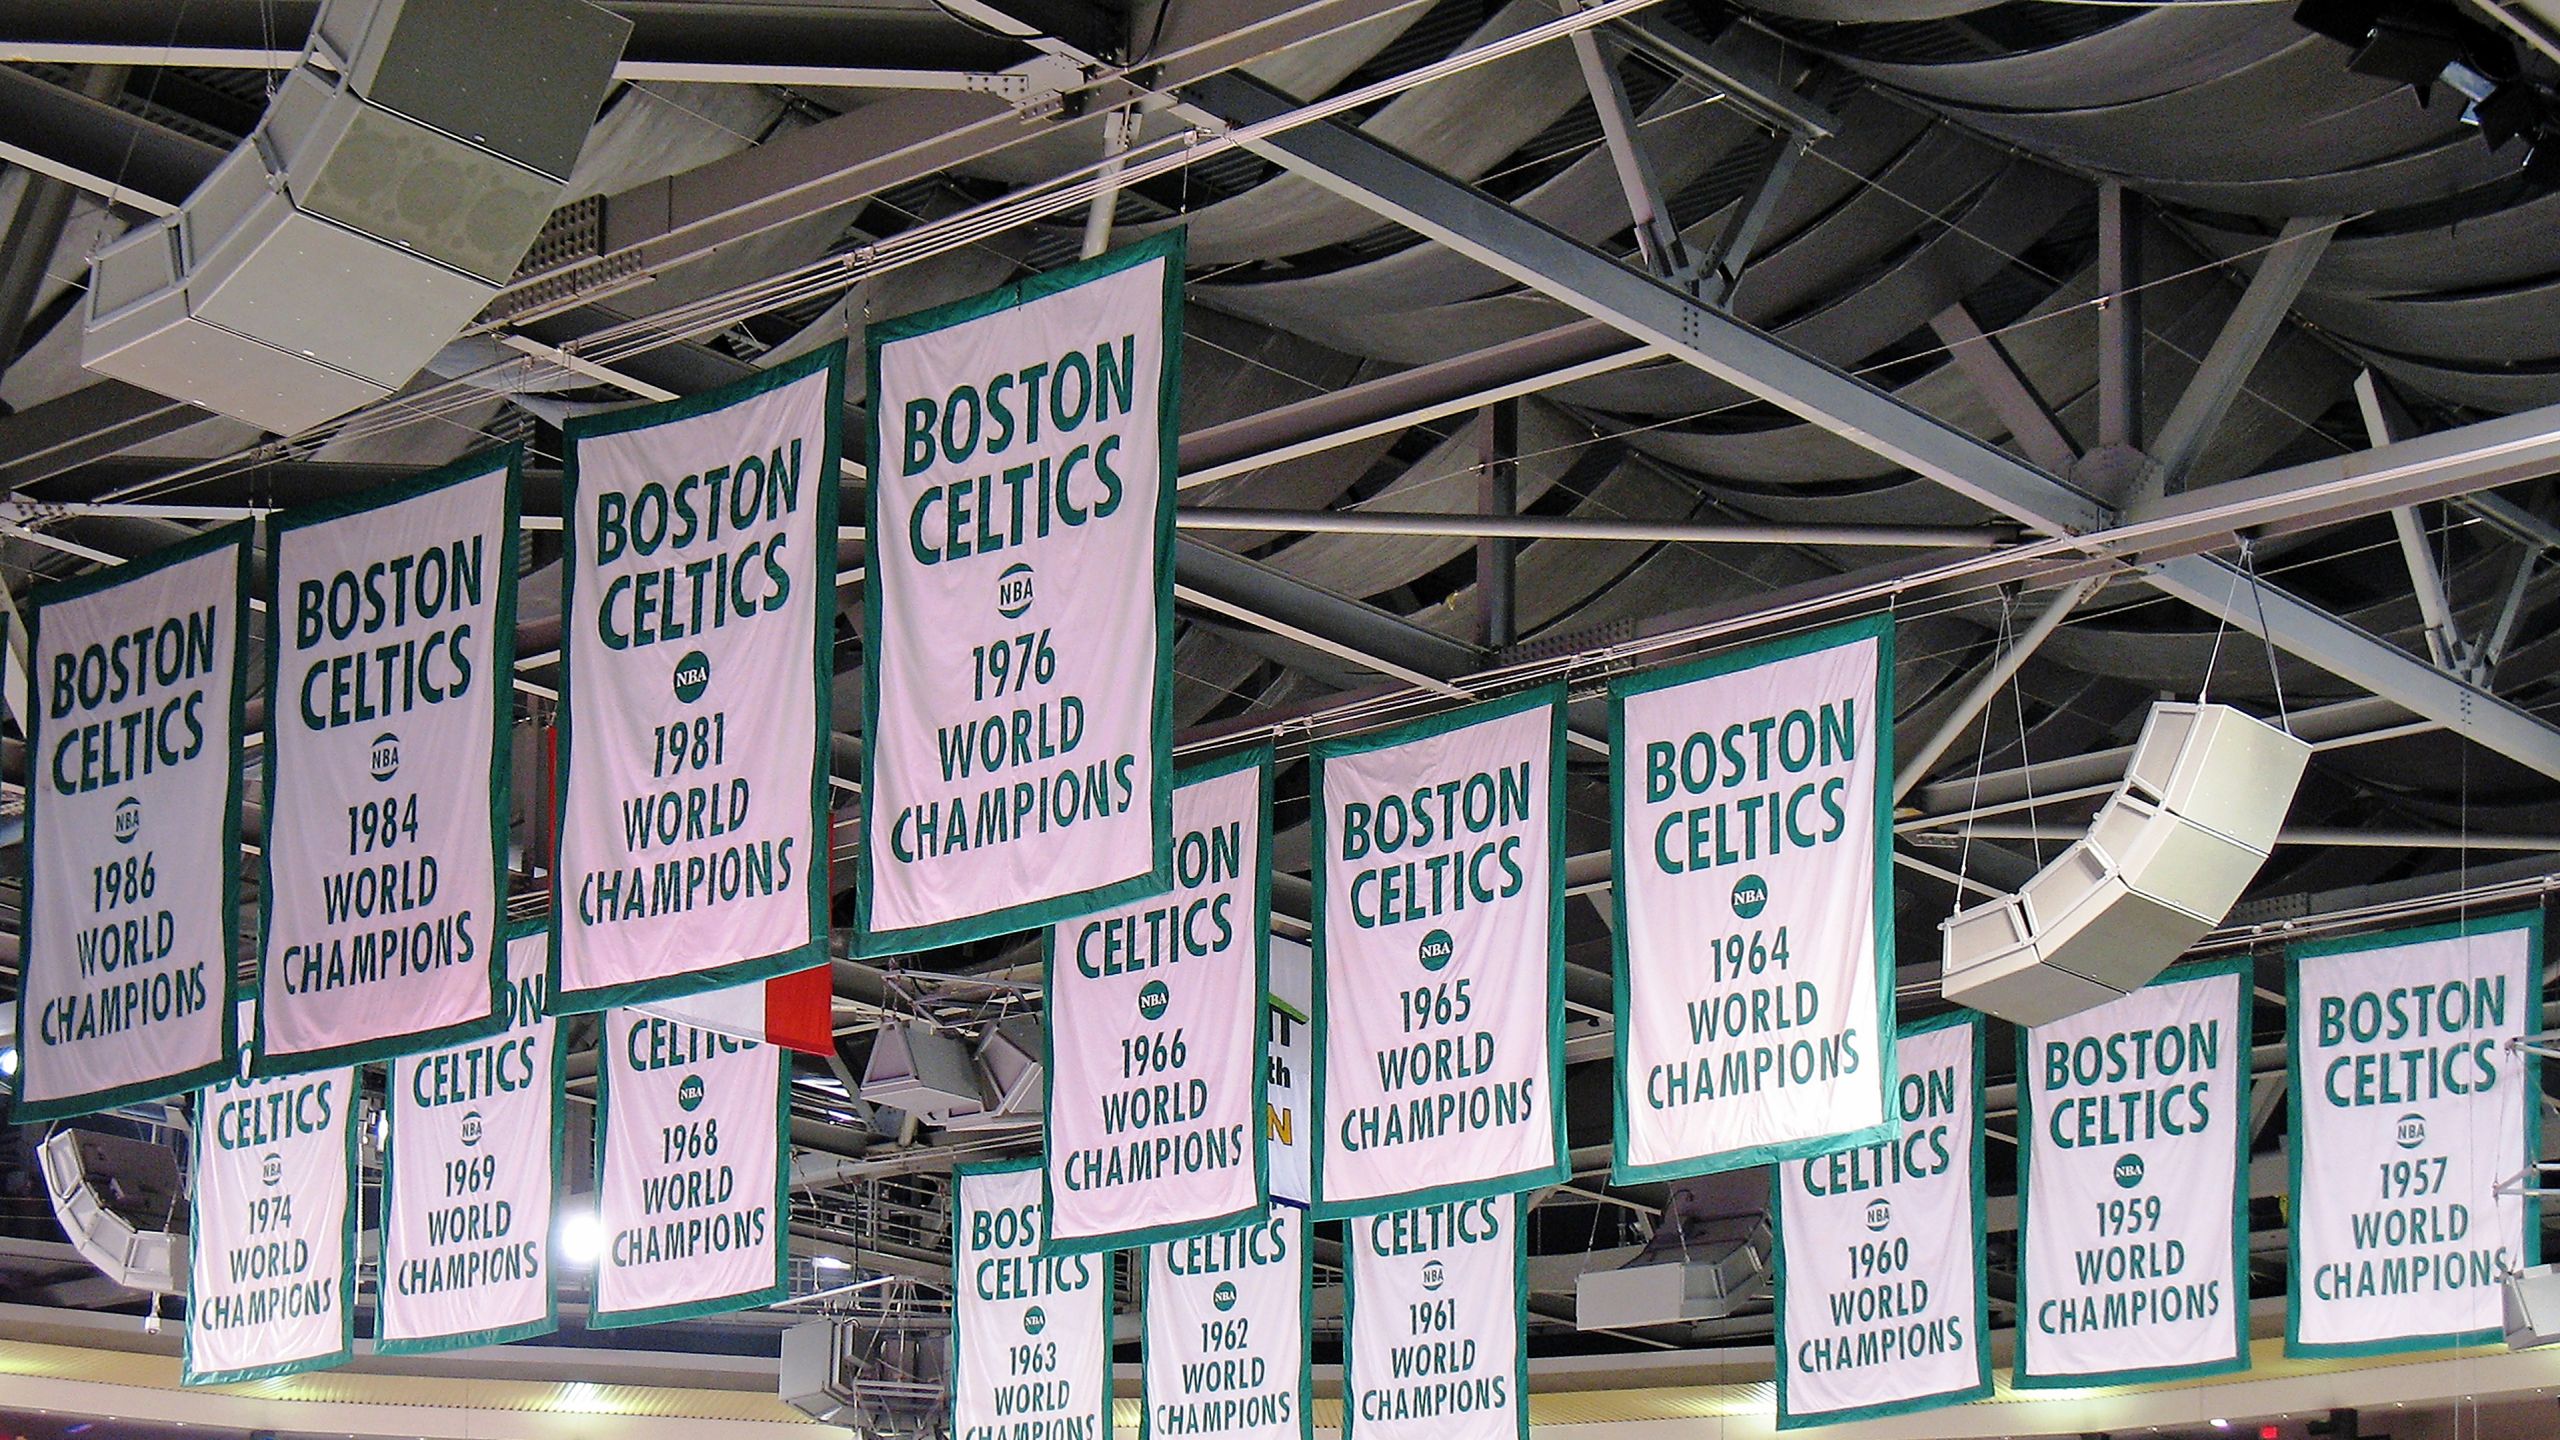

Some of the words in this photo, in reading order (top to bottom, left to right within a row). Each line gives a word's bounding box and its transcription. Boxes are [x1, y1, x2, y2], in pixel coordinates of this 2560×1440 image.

[903, 334, 1134, 477] BOSTON
[598, 438, 801, 566] BOSTON
[910, 435, 1122, 565] CELTICS
[297, 535, 482, 650] BOSTON
[598, 532, 790, 650] CELTICS
[999, 578, 1034, 605] NBA
[51, 606, 215, 719] BOSTON
[301, 624, 471, 730] CELTICS
[676, 666, 707, 688] NBA
[973, 628, 1055, 701] 1976
[53, 690, 203, 795] CELTICS
[372, 746, 399, 768] NBA
[654, 712, 723, 777] 1981
[938, 696, 1084, 781] WORLD
[1647, 698, 1854, 804] BOSTON
[115, 808, 139, 830] NBA
[349, 793, 418, 855] 1984
[623, 778, 749, 852] WORLD
[891, 754, 1134, 863] CHAMPIONS
[1343, 762, 1529, 861] BOSTON
[1655, 777, 1845, 874] CELTICS
[94, 851, 155, 912] 1986
[324, 856, 437, 925] WORLD
[580, 837, 793, 926] CHAMPIONS
[1351, 836, 1523, 928] CELTICS
[1735, 889, 1766, 906] NBA
[77, 911, 174, 979] WORLD
[283, 911, 473, 995] CHAMPIONS
[1077, 893, 1232, 979] CELTICS
[1420, 942, 1451, 960] NBA
[1711, 926, 1789, 982] 1964
[41, 962, 206, 1046] CHAMPIONS
[1140, 993, 1167, 1008] NBA
[1401, 979, 1470, 1032] 1965
[1688, 981, 1818, 1044] WORLD
[2319, 975, 2505, 1047] BOSTON
[414, 1036, 534, 1108] CELTICS
[1122, 1029, 1186, 1078] 1966
[1378, 1032, 1494, 1092] WORLD
[1648, 1029, 1859, 1110] CHAMPIONS
[2046, 1020, 2217, 1090] BOSTON
[2325, 1039, 2496, 1107] CELTICS
[218, 1081, 331, 1150] CELTICS
[680, 1086, 702, 1098] NBA
[1102, 1079, 1207, 1134] WORLD
[1341, 1078, 1532, 1152] CHAMPIONS
[2050, 1082, 2209, 1149] CELTICS
[461, 1119, 482, 1136] NBA
[663, 1119, 718, 1163] 1968
[2398, 1123, 2425, 1139] NBA
[446, 1155, 494, 1193] 1969
[1065, 1124, 1243, 1191] CHAMPIONS
[1803, 1125, 1949, 1197] CELTICS
[2116, 1163, 2143, 1178] NBA
[2381, 1157, 2447, 1199] 1957
[249, 1195, 291, 1234] 1974
[643, 1166, 733, 1214] WORLD
[1867, 1208, 1889, 1223] NBA
[2097, 1196, 2161, 1237] 1959
[429, 1201, 511, 1246] WORLD
[614, 1207, 765, 1267] CHAMPIONS
[1168, 1218, 1286, 1276] CELTICS
[1371, 1198, 1498, 1257] CELTICS
[2352, 1204, 2468, 1249] WORLD
[230, 1239, 308, 1283] WORLD
[399, 1242, 538, 1295] CHAMPIONS
[977, 1254, 1089, 1300] CELTICS
[1424, 1268, 1443, 1282] NBA
[1849, 1237, 1908, 1279] 1960
[2076, 1240, 2184, 1285] WORLD
[2314, 1247, 2507, 1300] CHAMPIONS
[202, 1278, 331, 1330] CHAMPIONS
[1410, 1299, 1454, 1335] 1961
[1830, 1280, 1928, 1326] WORLD
[2039, 1280, 2218, 1334] CHAMPIONS
[1010, 1342, 1056, 1375] 1963
[1202, 1318, 1248, 1352] 1962
[1392, 1339, 1475, 1378] WORLD
[1799, 1316, 1962, 1373] CHAMPIONS
[995, 1381, 1069, 1416] WORLD
[1183, 1357, 1264, 1394] WORLD
[1362, 1376, 1505, 1421] CHAMPIONS
[1158, 1392, 1290, 1434] CHAMPIONS
